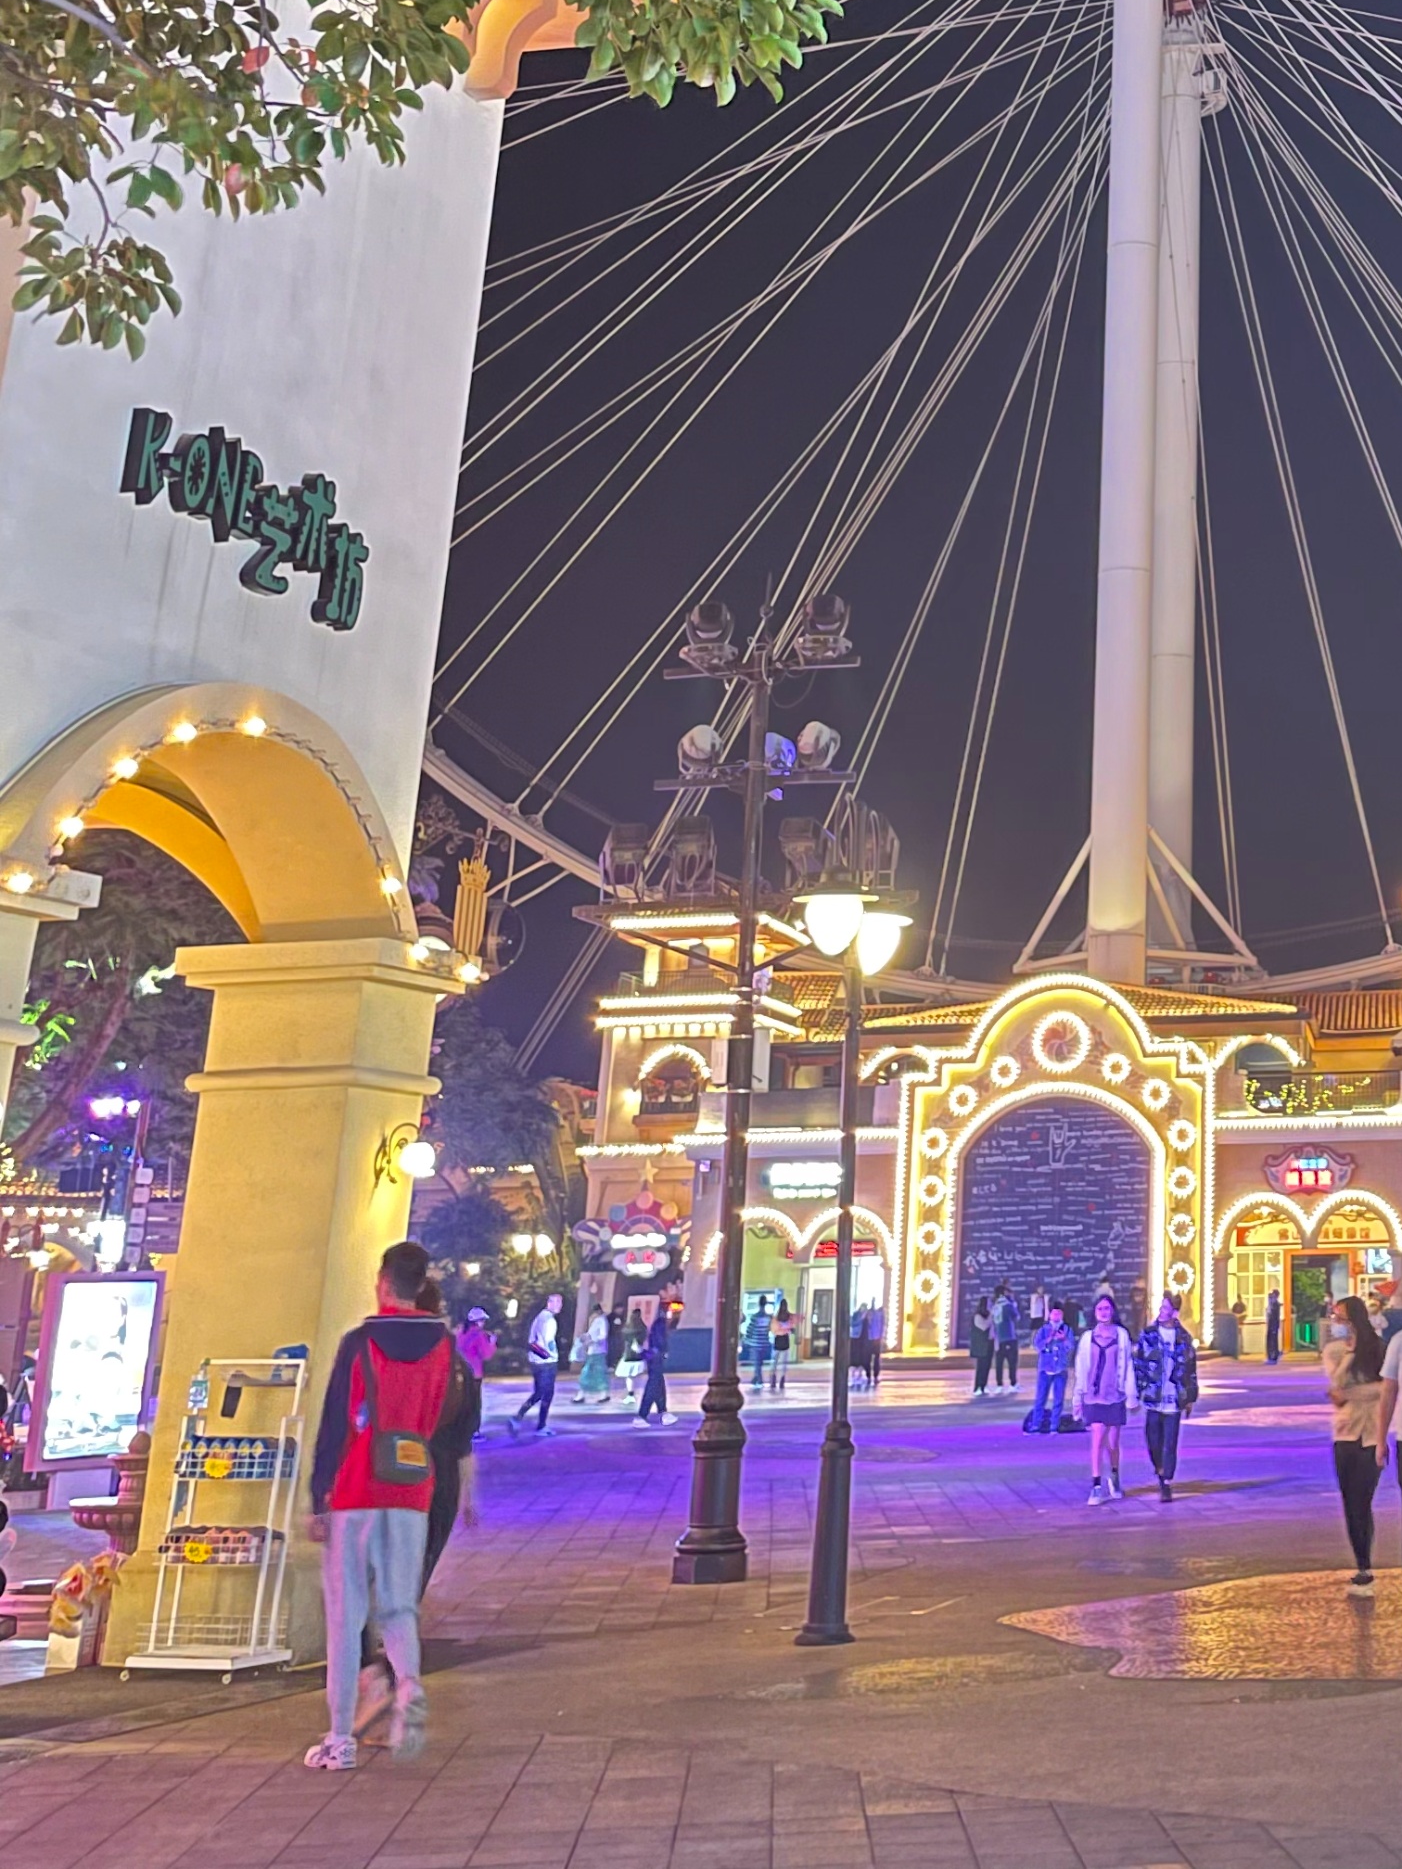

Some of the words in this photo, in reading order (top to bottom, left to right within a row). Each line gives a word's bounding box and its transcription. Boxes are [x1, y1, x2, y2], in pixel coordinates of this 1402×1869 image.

[120, 407, 264, 543] K-ONE
[239, 473, 369, 631] 艺术坊
